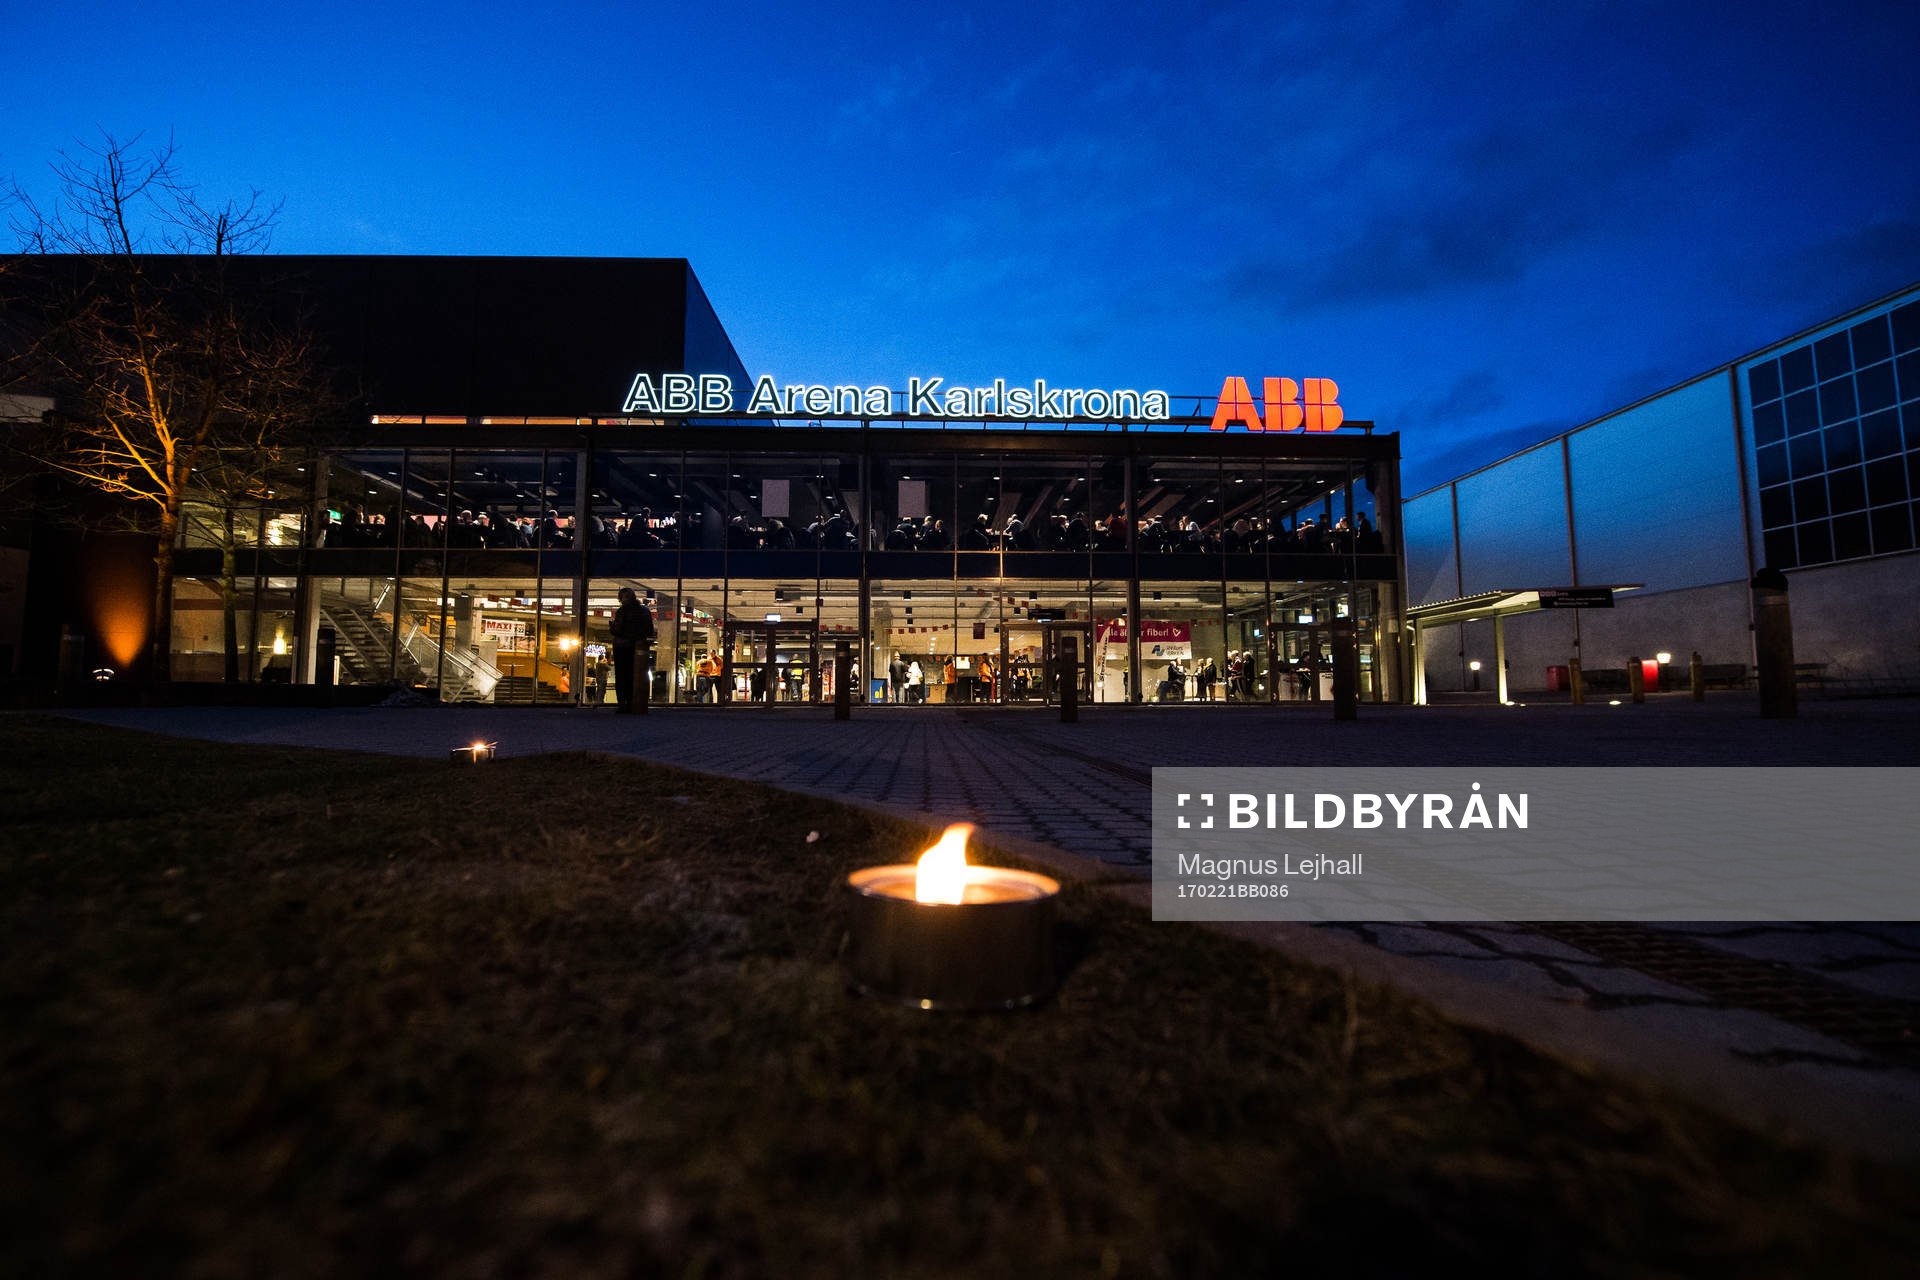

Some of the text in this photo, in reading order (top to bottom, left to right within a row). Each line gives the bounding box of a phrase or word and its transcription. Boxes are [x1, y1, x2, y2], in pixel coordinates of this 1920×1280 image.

[623, 373, 1170, 419] ABB Arena Karlskrona
[1210, 376, 1345, 433] ABB
[1147, 628, 1169, 637] fiber!
